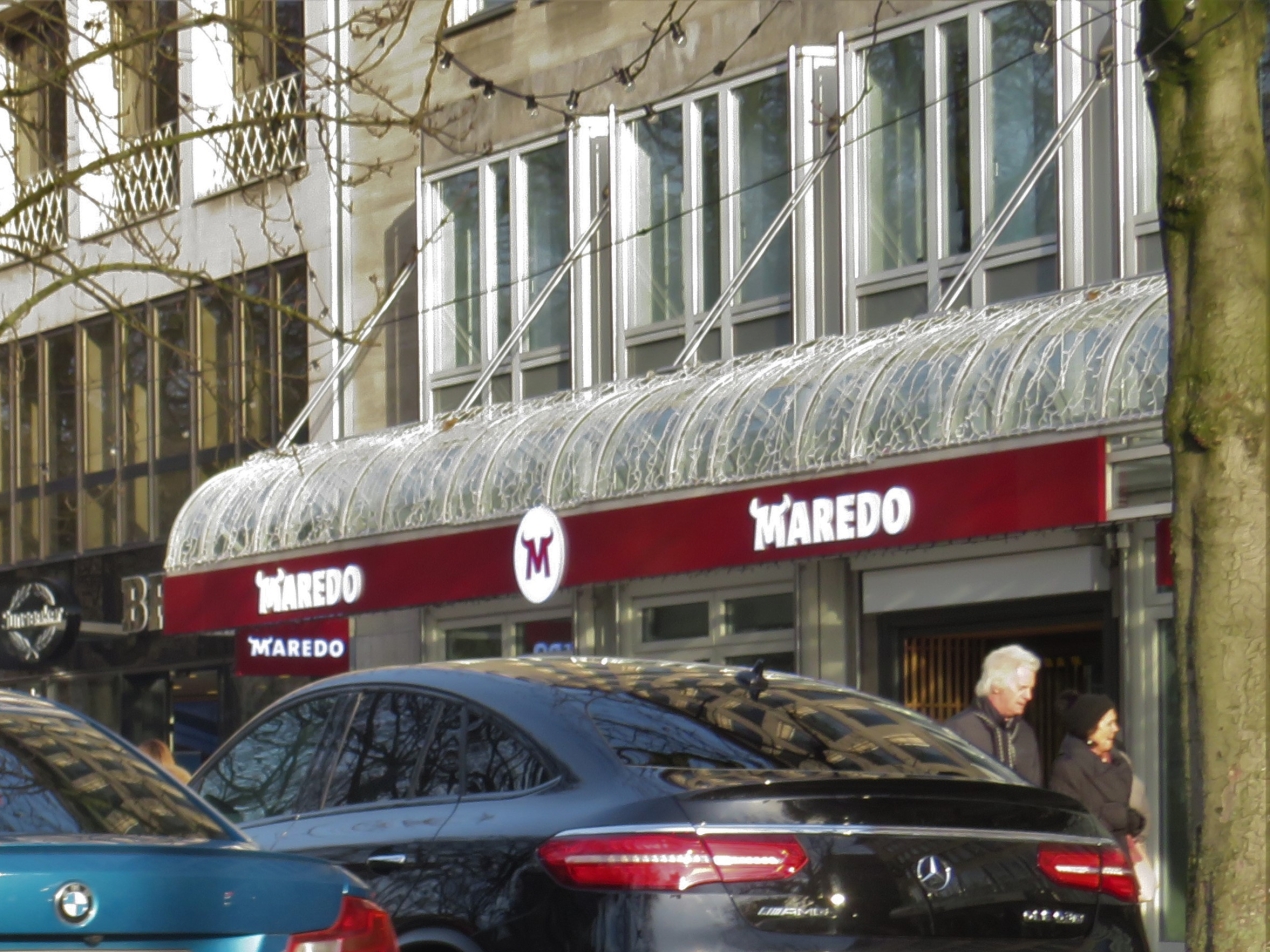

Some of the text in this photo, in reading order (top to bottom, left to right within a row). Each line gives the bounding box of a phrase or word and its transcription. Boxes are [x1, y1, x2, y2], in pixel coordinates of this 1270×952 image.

[749, 486, 913, 551] MAREDO
[521, 527, 554, 581] M
[255, 564, 364, 615] MAREDO
[247, 635, 346, 658] MAREDO
